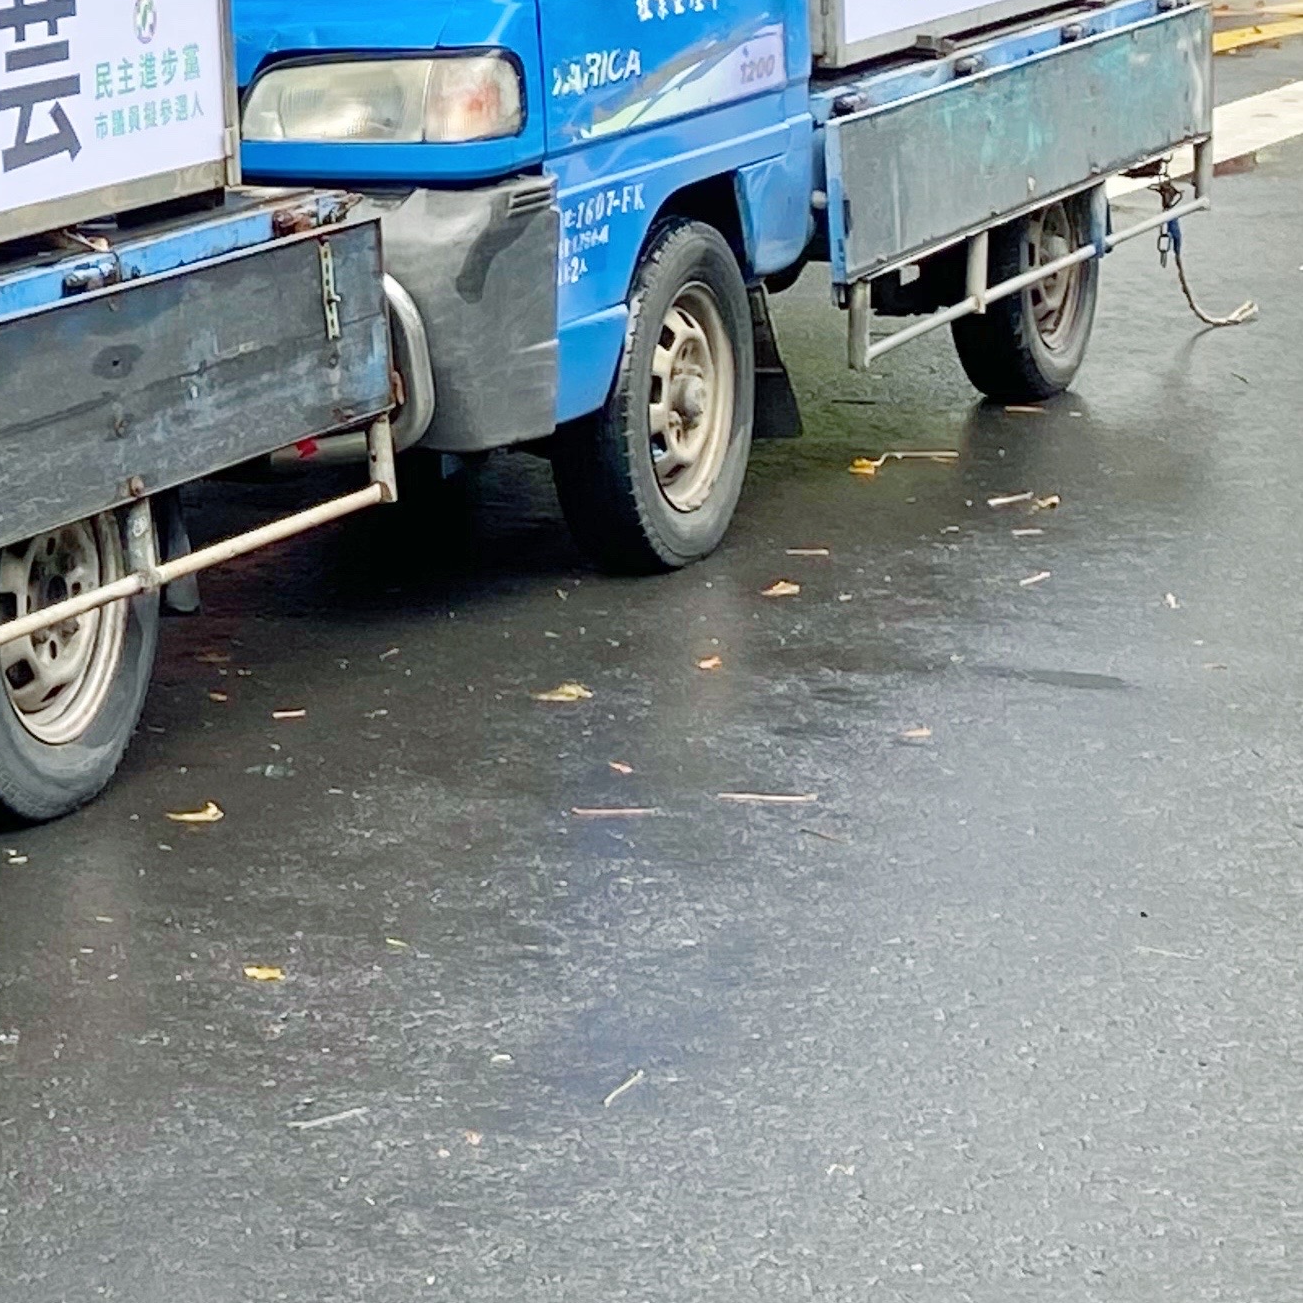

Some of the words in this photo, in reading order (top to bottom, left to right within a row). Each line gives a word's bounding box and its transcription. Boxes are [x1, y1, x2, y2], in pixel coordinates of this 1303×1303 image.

[95, 43, 201, 100] 民主進步黨
